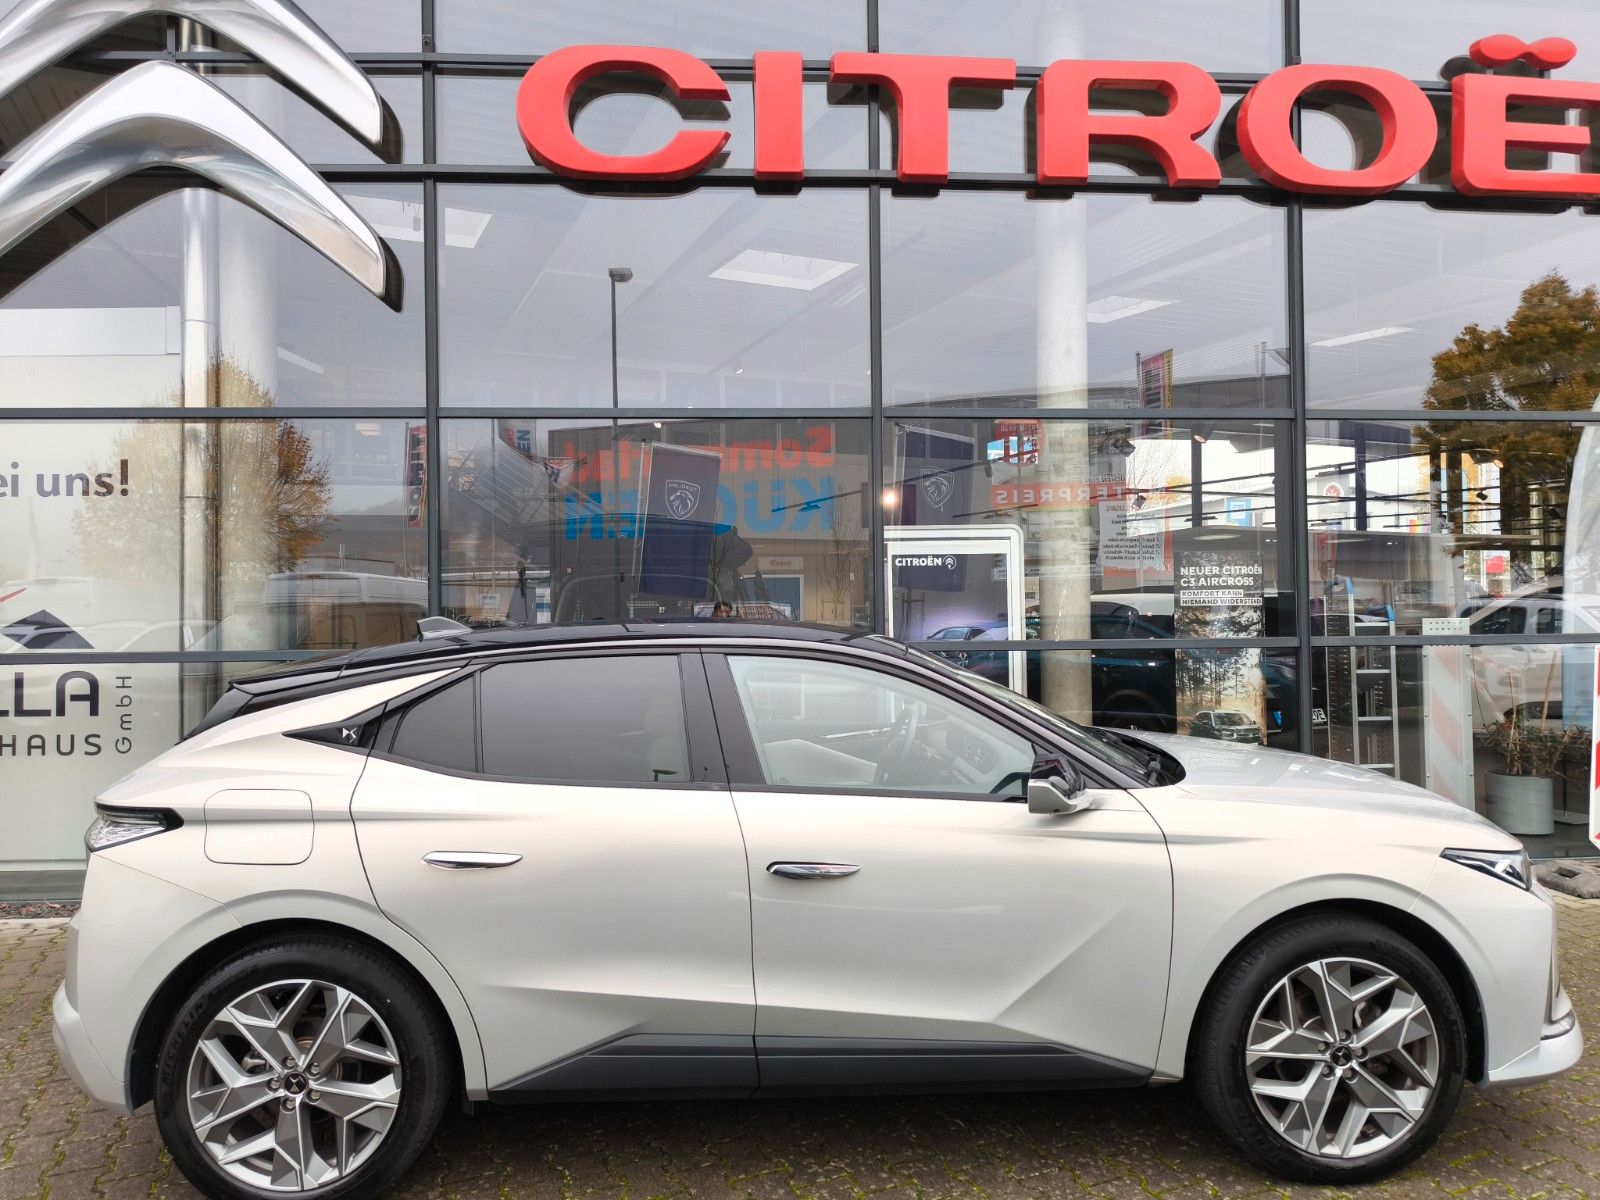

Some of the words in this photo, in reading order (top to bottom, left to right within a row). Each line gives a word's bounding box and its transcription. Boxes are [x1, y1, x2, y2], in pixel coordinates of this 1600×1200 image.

[36, 459, 129, 497] uns!
[895, 555, 942, 567] CITROËN
[1180, 566, 1220, 576] NEUER
[1223, 564, 1263, 575] CITROËN
[1180, 577, 1196, 587] C3
[1198, 577, 1254, 587] AIRCROSS
[0, 671, 100, 717] LA
[115, 676, 132, 754] GmbH
